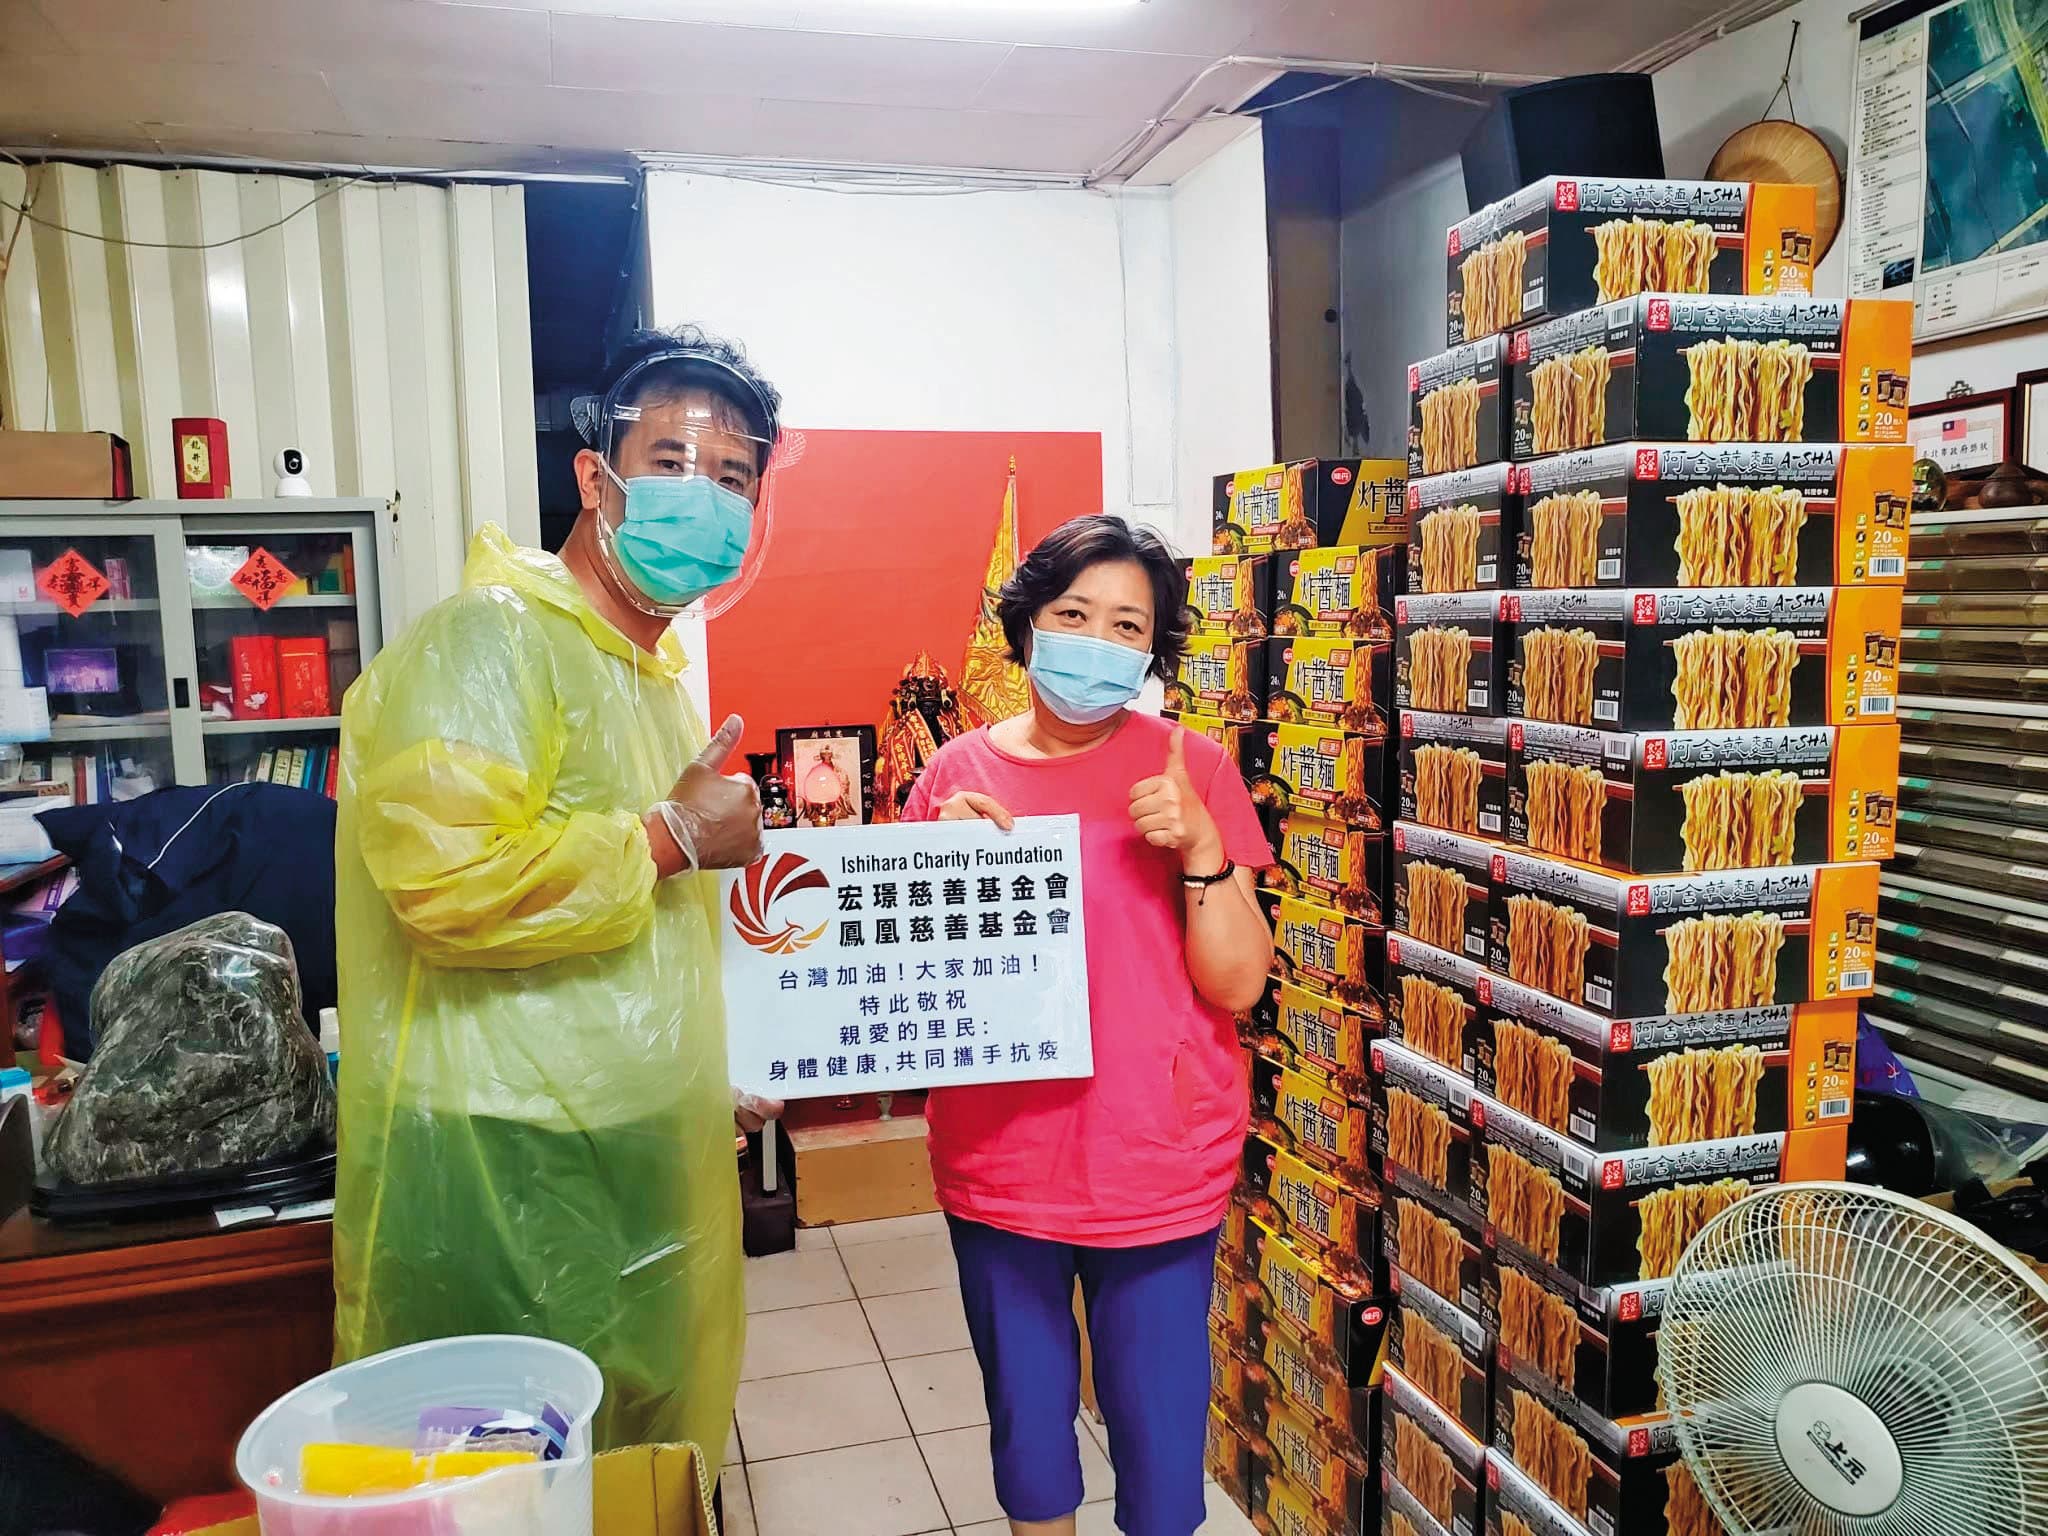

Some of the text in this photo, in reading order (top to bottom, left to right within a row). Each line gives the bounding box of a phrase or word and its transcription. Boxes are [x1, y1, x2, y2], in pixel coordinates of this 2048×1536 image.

[1692, 187, 1742, 204] A-SHA
[1788, 304, 1839, 321] A-SHA
[1780, 449, 1834, 469] A-SHA
[1773, 593, 1826, 612] A-SHA
[1780, 732, 1828, 752] A-SHA
[841, 845, 1063, 874] Ishihara Charity Foundation
[837, 872, 1069, 912] 宏璟慈善基金會
[1760, 873, 1809, 896] A-SHA
[839, 907, 1071, 947] 鳳凰慈善基金會
[859, 989, 966, 1016] 特此敬祝
[1740, 1006, 1788, 1026] A-SHA
[839, 1018, 989, 1046] 親愛的里民:
[768, 1040, 1060, 1081] 身體健康,共同攜手抗疫
[1732, 1139, 1778, 1161] A-SHA
